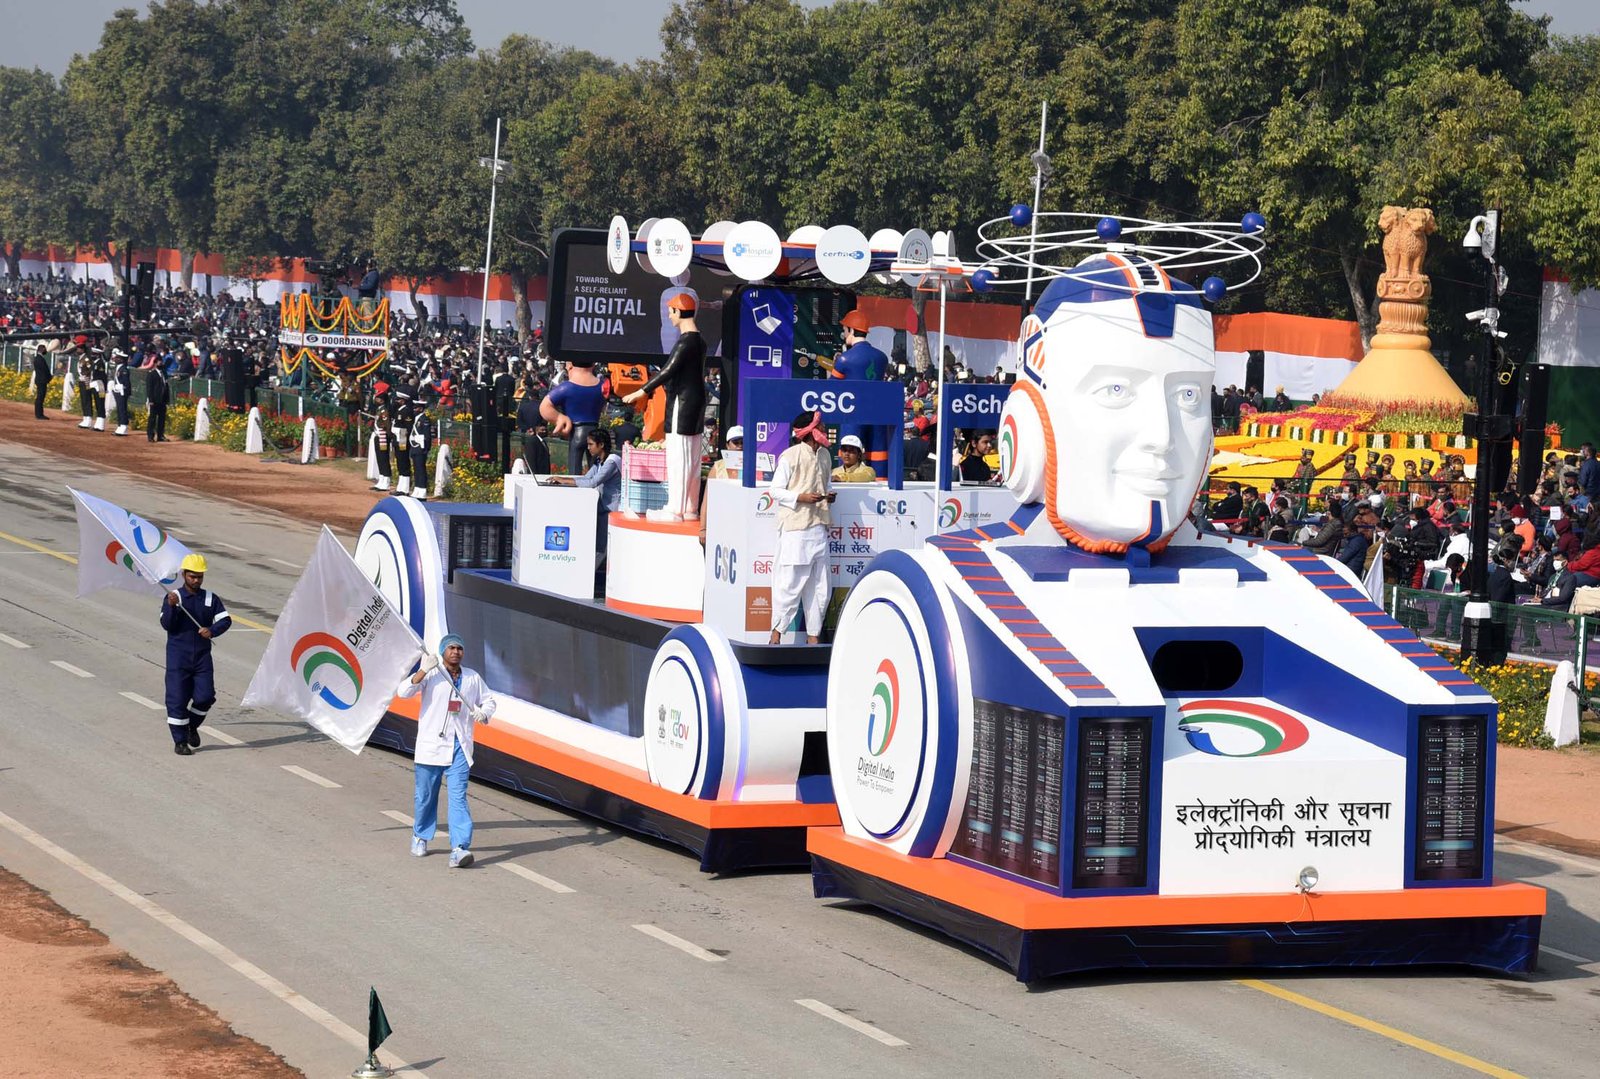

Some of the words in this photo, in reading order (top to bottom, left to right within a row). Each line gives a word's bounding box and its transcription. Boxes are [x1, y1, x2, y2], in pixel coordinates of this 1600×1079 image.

[668, 243, 684, 252] GOV
[575, 275, 609, 284] TOWARDS
[580, 286, 628, 295] SELF-RELIANT
[574, 296, 647, 316] DIGITAL
[572, 316, 625, 336] INDIA
[321, 336, 385, 348] DOORDARSHAN
[801, 390, 855, 414] CSC
[876, 499, 907, 515] CSC
[963, 511, 979, 519] Digital
[847, 521, 875, 540] सेवा
[538, 553, 551, 561] PM
[552, 553, 577, 563] eVidya
[714, 544, 737, 585] CSC
[346, 609, 373, 647] Digital
[359, 631, 376, 652] Power
[673, 722, 689, 740] GOV
[857, 756, 879, 777] Digital
[879, 763, 895, 780] India
[1175, 797, 1285, 826] इलेक्ट्रॉनिकी
[1294, 796, 1330, 821] और
[1338, 802, 1392, 826] सूचना
[1305, 825, 1372, 848] मंत्रालय
